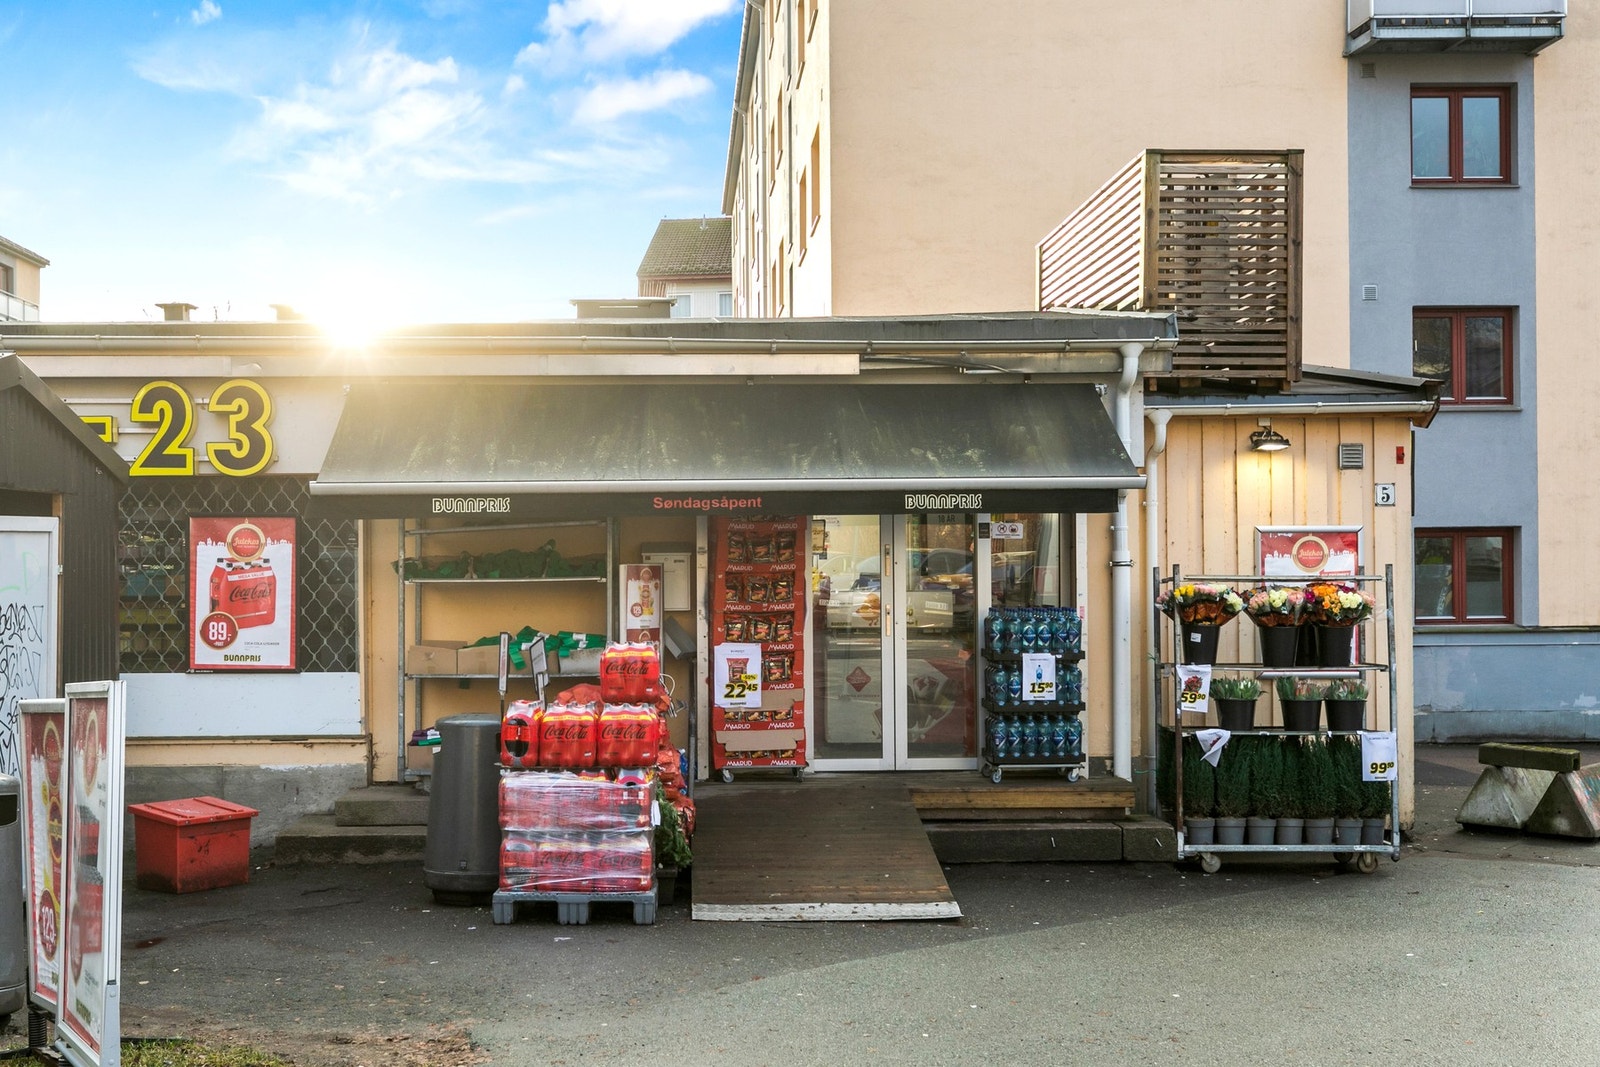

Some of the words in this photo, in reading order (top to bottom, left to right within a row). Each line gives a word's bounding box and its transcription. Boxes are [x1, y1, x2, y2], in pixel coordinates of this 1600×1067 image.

[905, 494, 982, 509] BUNNPRIS
[1381, 486, 1390, 503] 5
[432, 497, 510, 513] BUNNPRIS
[653, 496, 762, 511] Søndagsåpent
[768, 603, 795, 611] MAARUD
